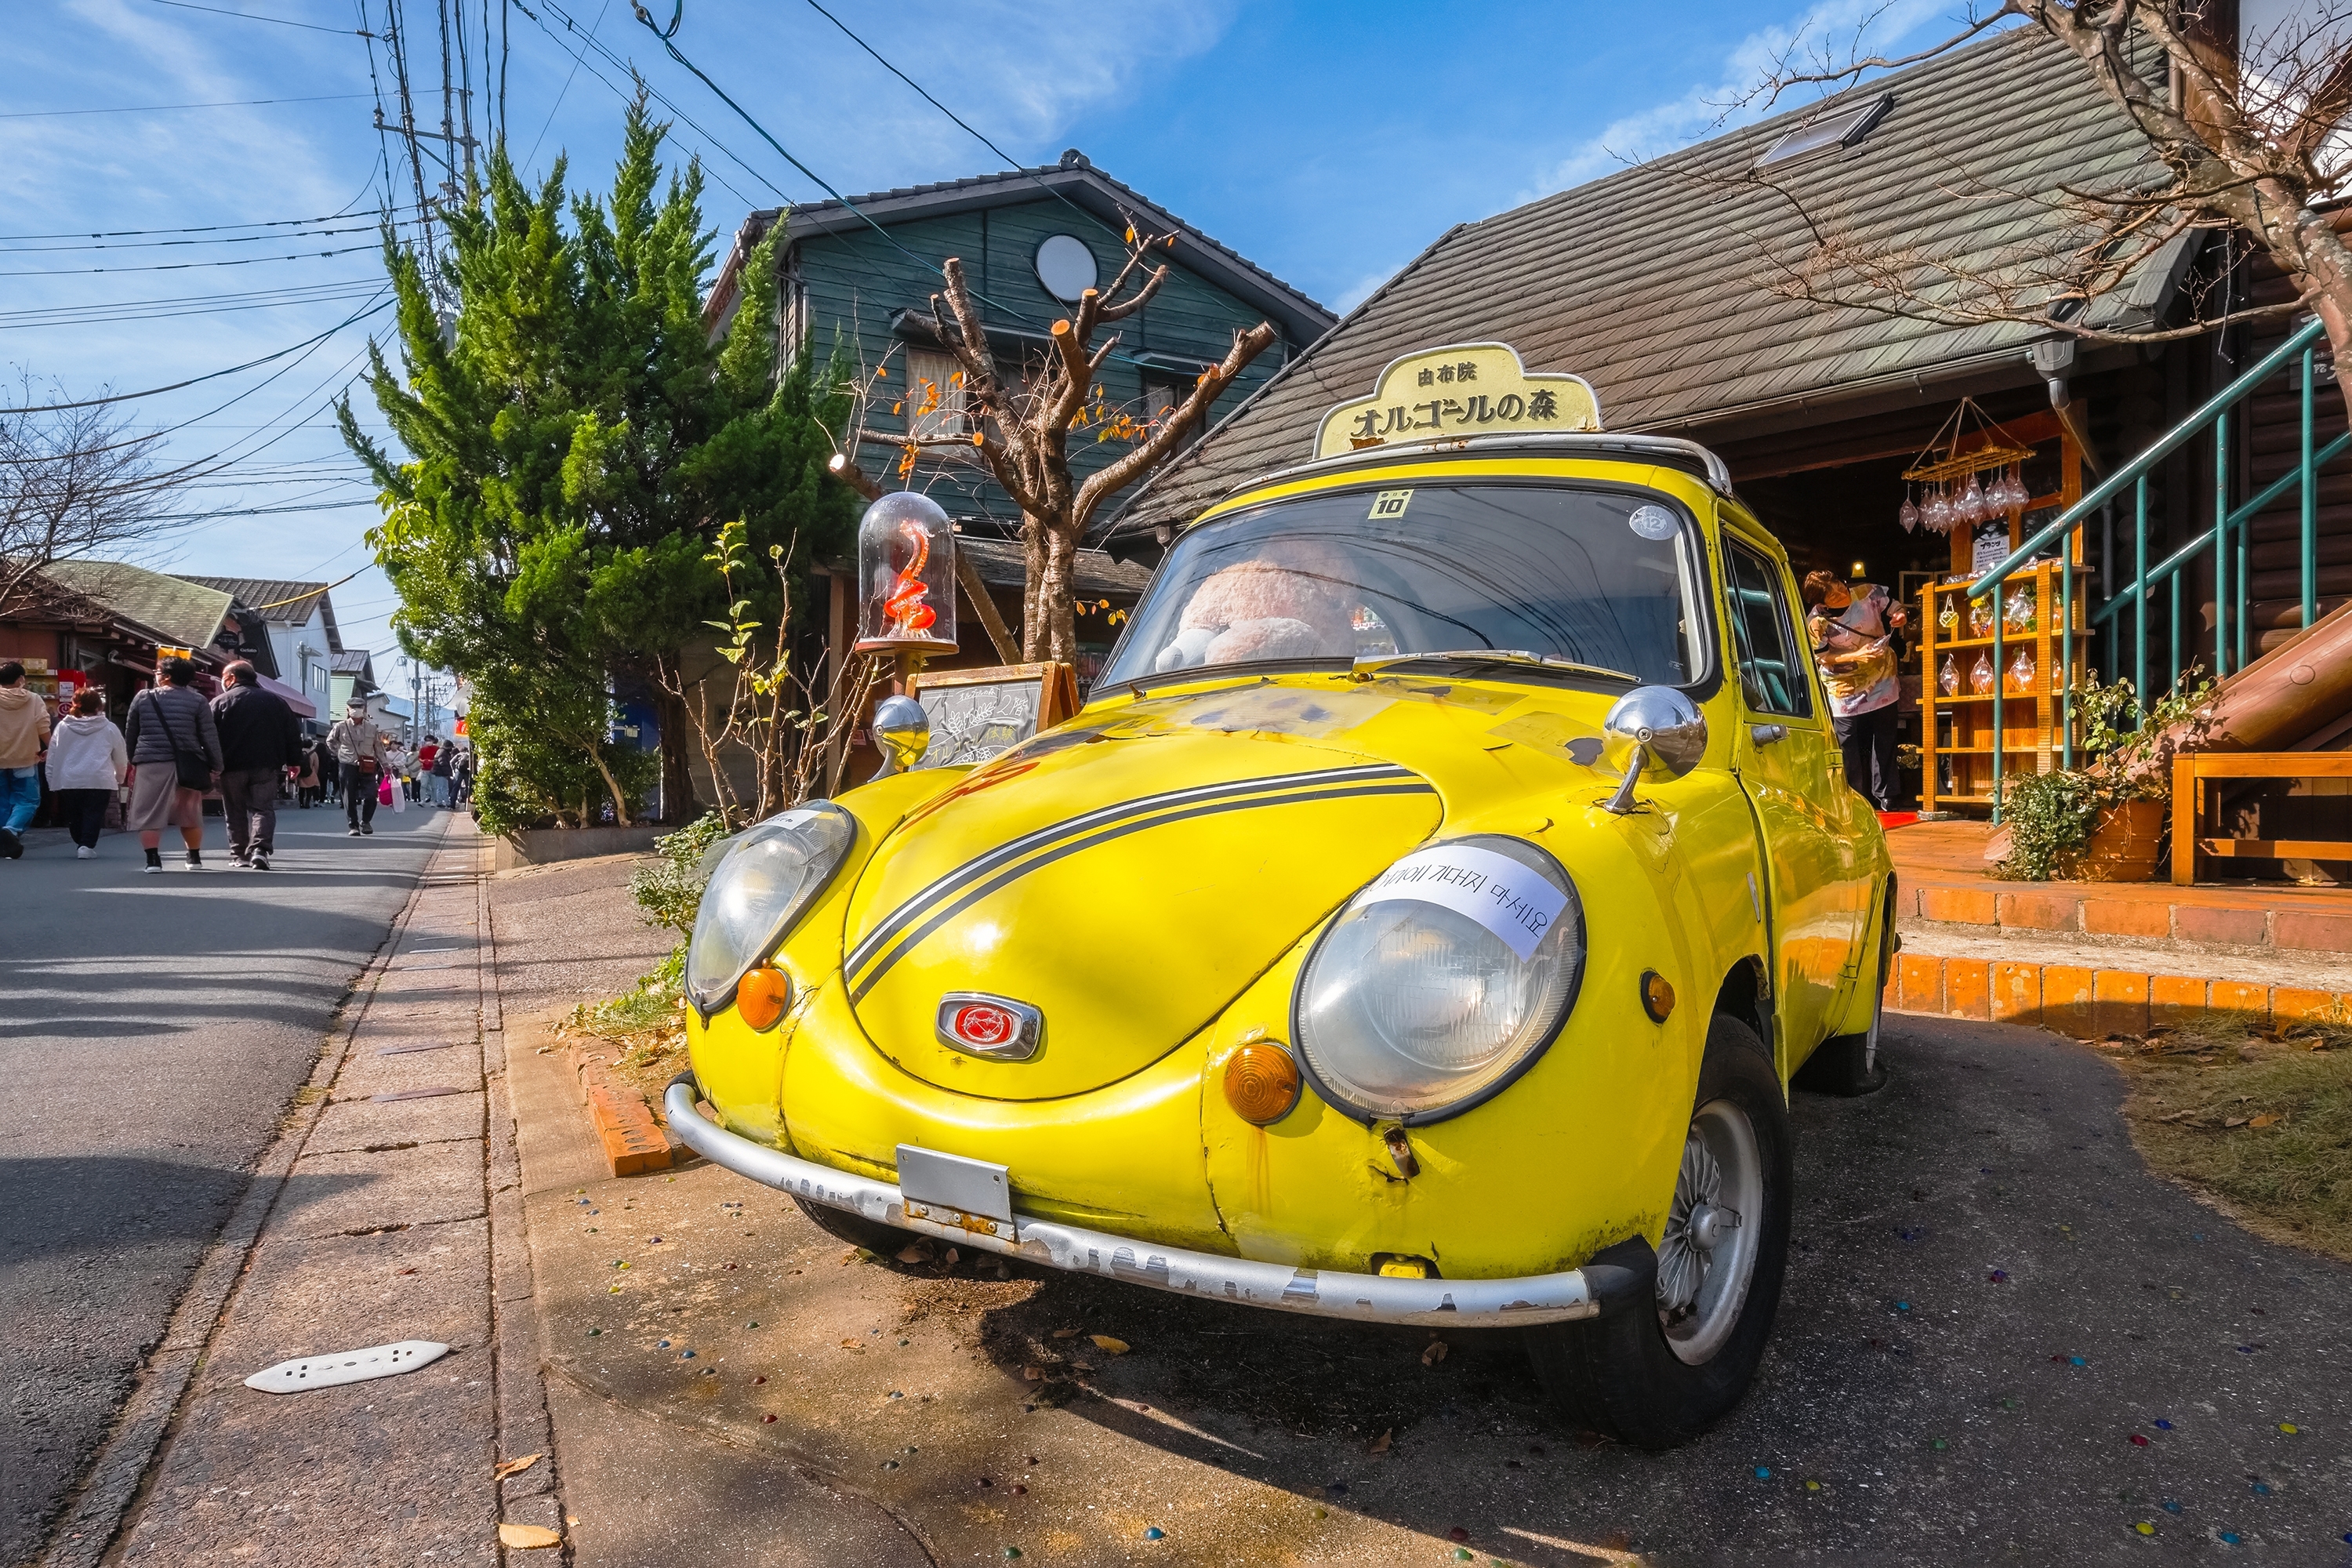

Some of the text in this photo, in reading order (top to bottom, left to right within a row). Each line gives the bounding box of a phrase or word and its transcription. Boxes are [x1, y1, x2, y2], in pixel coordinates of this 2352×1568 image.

[1417, 361, 1478, 387] 由布院
[1350, 388, 1559, 438] オルゴールの森
[1377, 498, 1405, 515] 10
[1646, 517, 1661, 530] 12
[996, 694, 1029, 717] 2階
[1428, 864, 1488, 894] 기대지
[1490, 884, 1548, 938] 마세요
